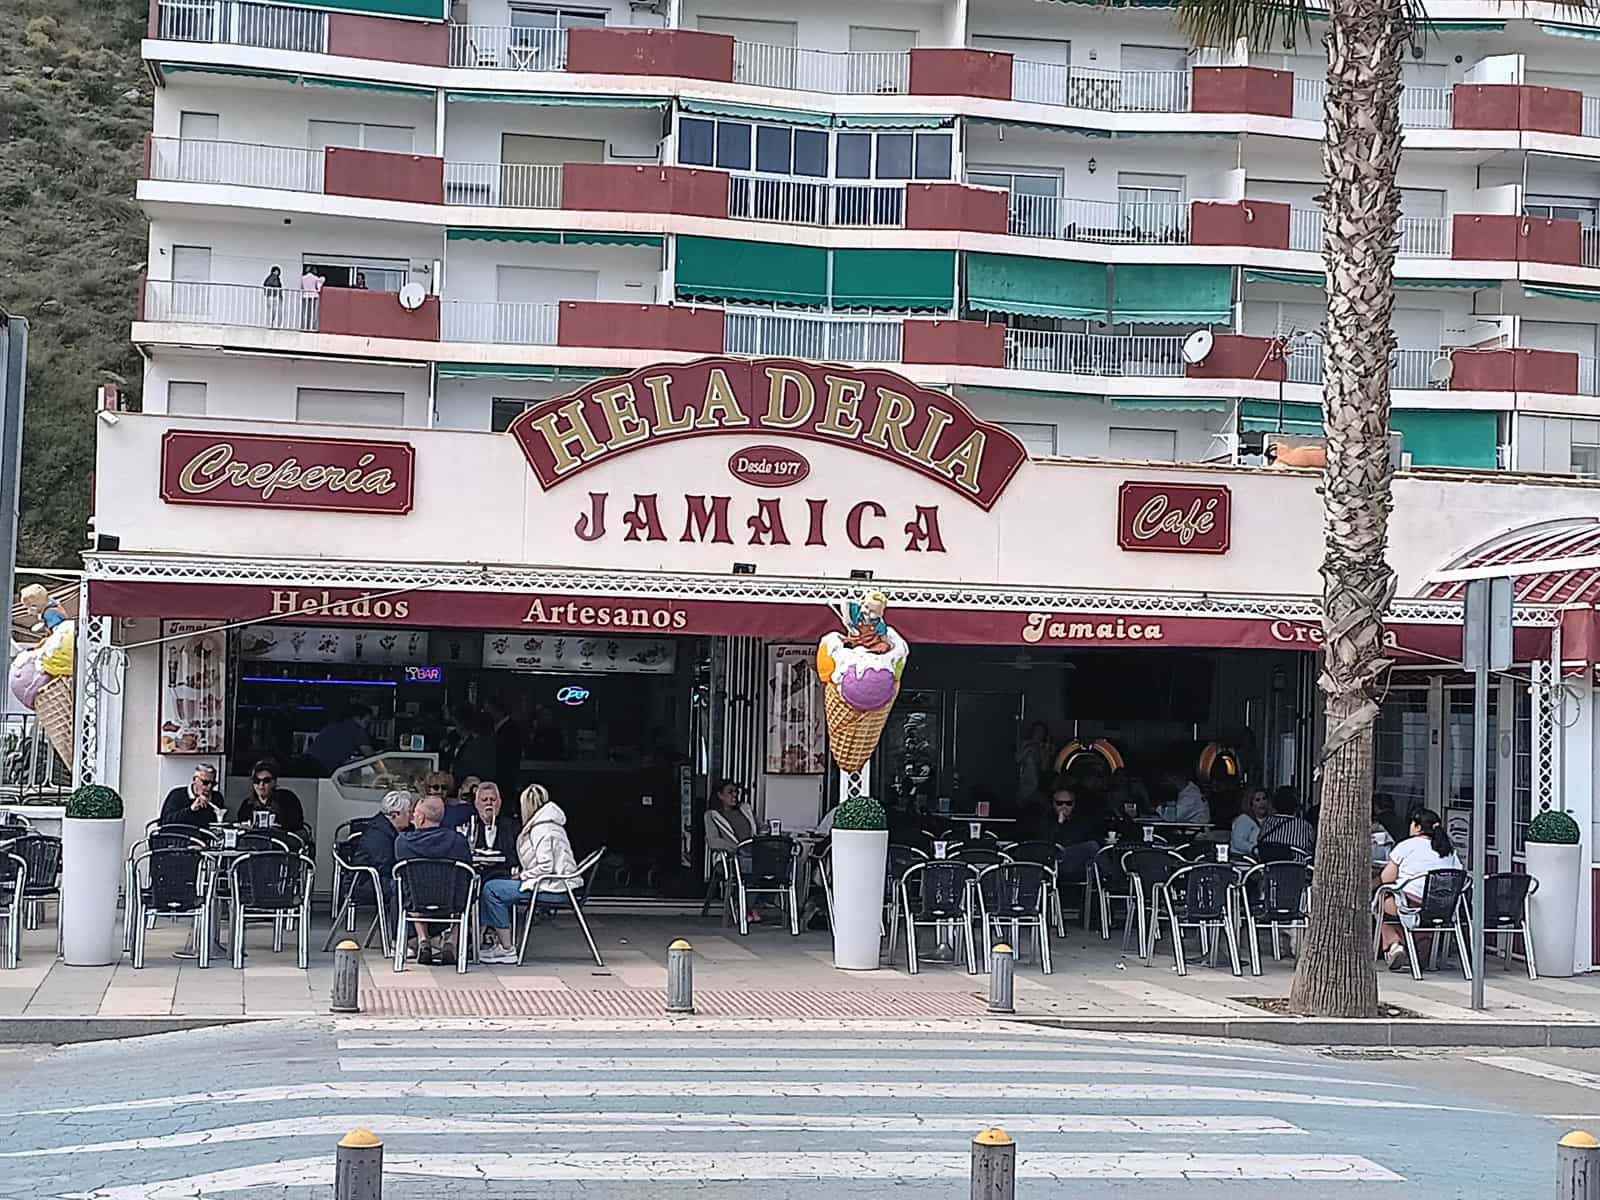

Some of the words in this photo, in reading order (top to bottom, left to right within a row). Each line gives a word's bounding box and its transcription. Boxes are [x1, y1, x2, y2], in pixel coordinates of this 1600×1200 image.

[532, 368, 986, 494] HELADERIA
[179, 443, 397, 500] Crepería
[737, 458, 772, 474] Desde
[774, 461, 801, 475] 1977
[574, 492, 947, 553] JAMAICA
[1132, 494, 1218, 545] Café
[270, 590, 409, 618] Helados
[522, 598, 687, 628] Artesanos
[1022, 612, 1163, 643] Jamaica
[417, 668, 439, 680] BAR
[556, 687, 590, 701] Open
